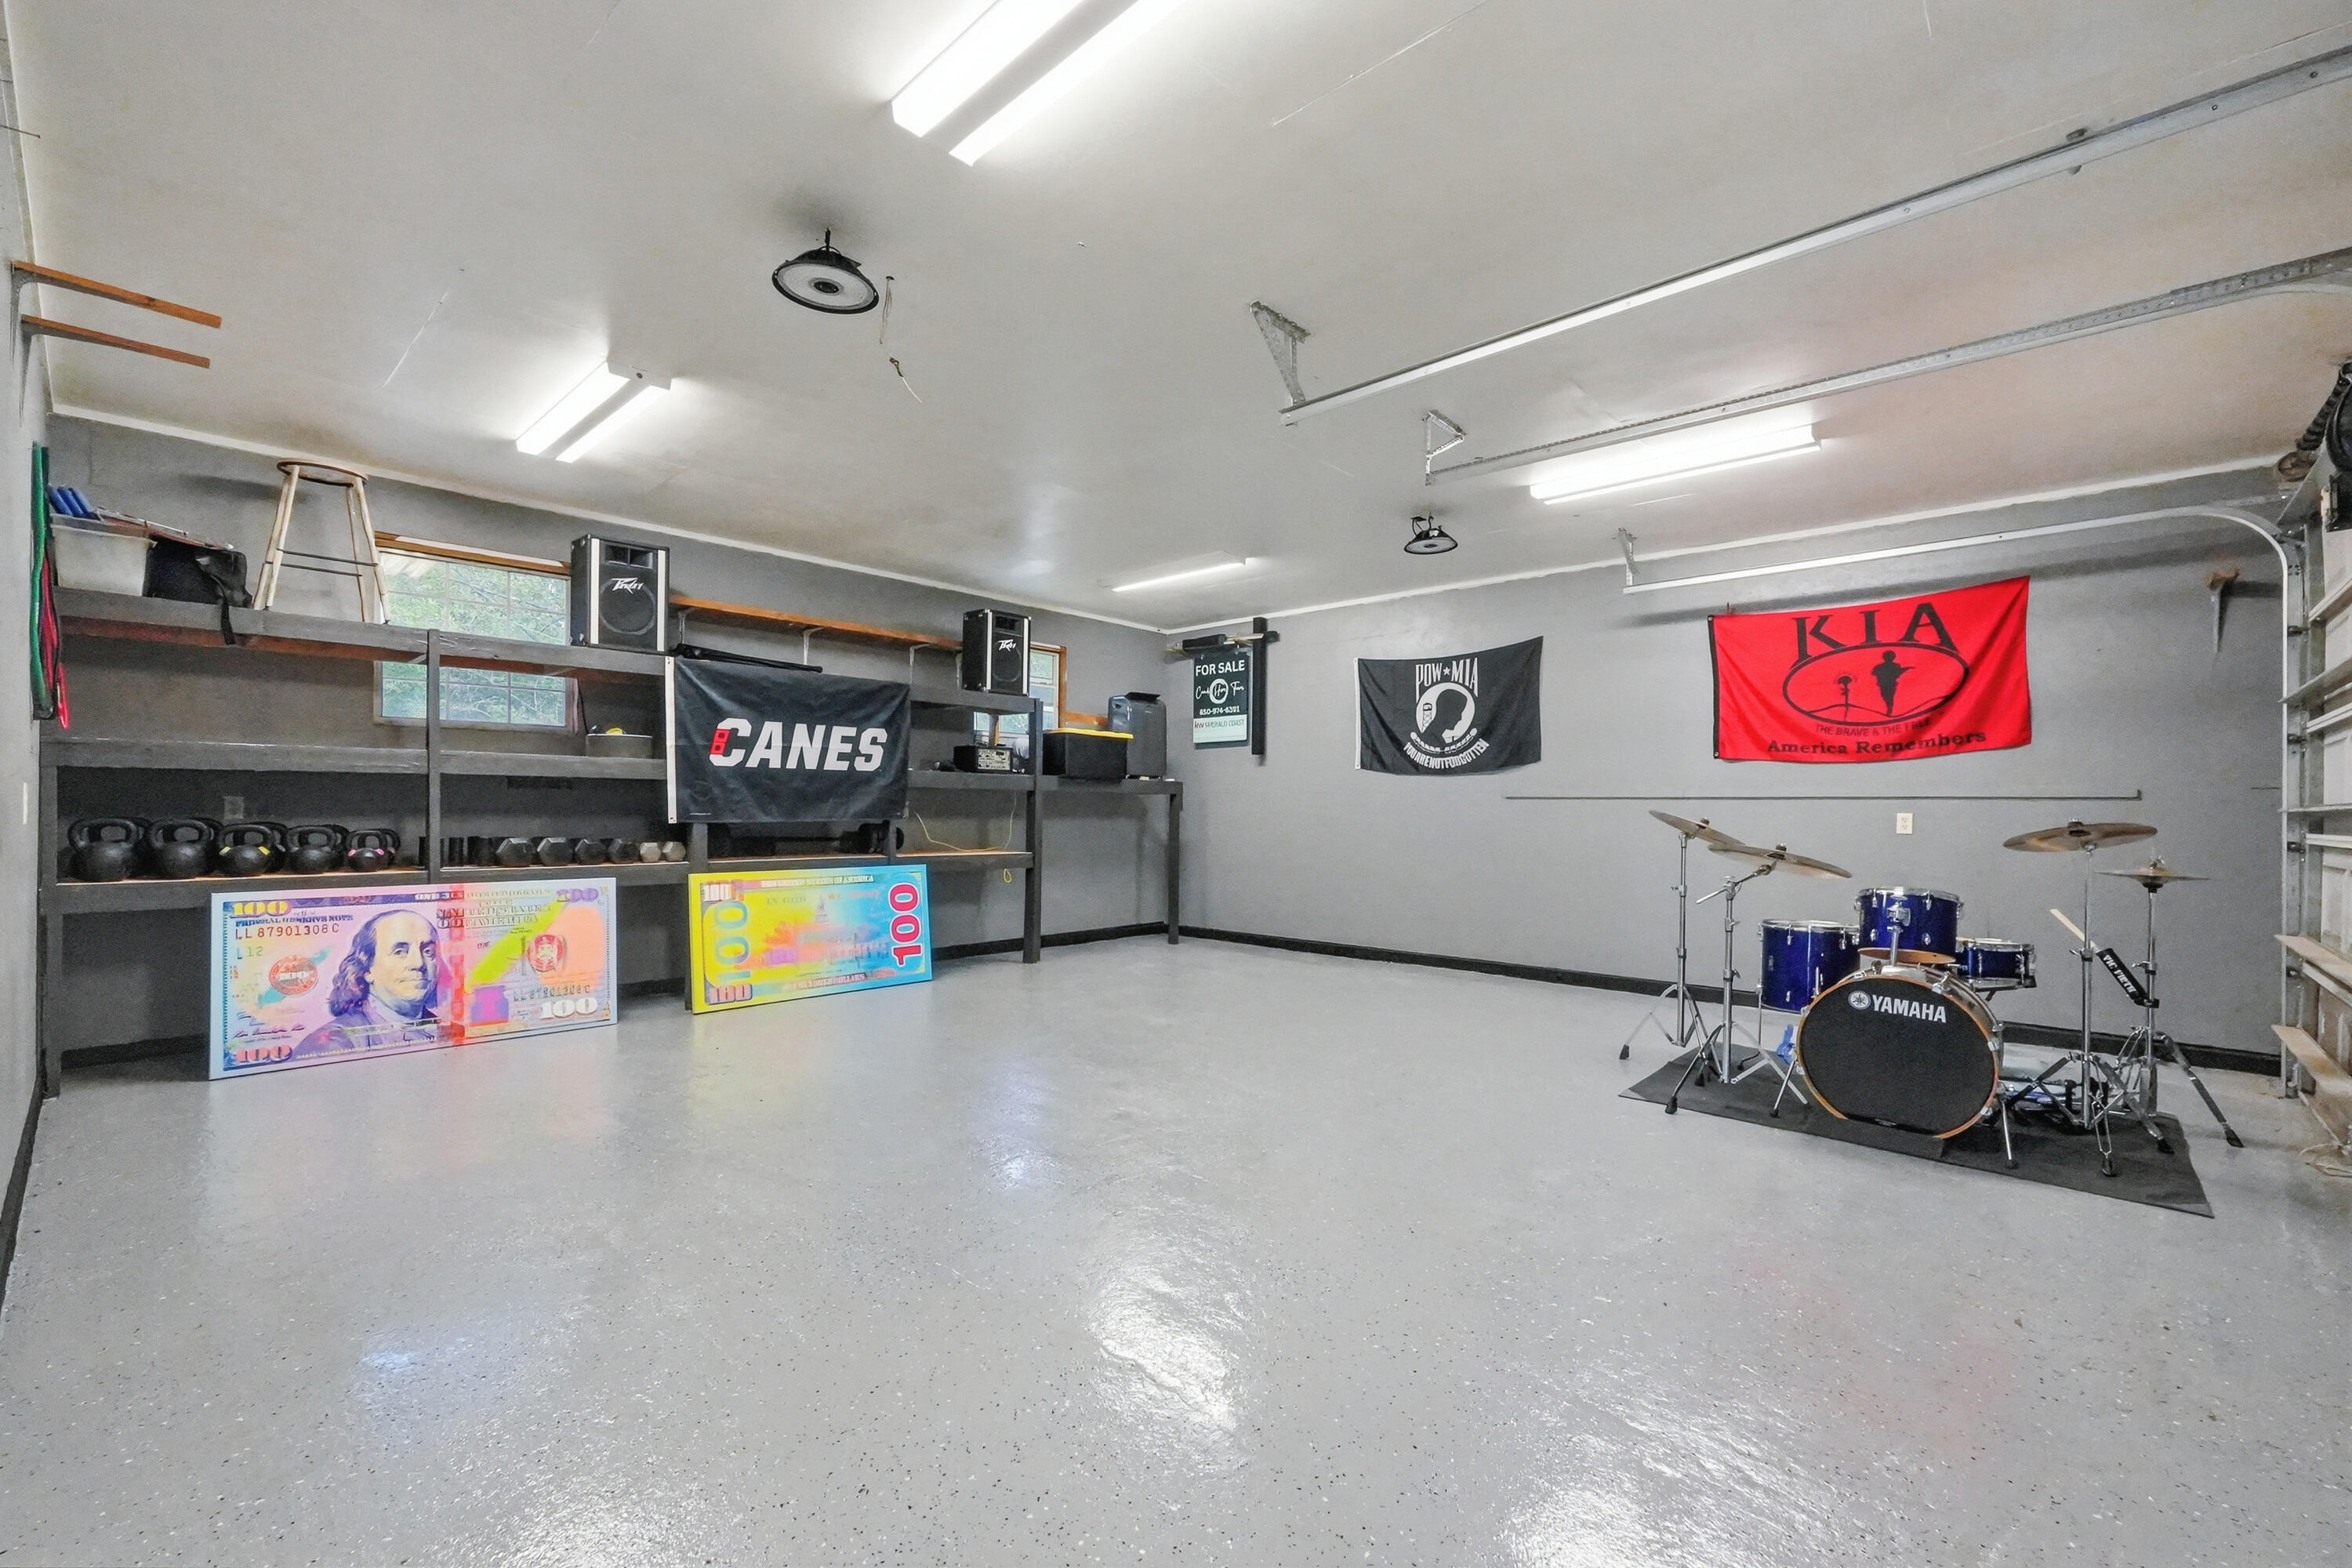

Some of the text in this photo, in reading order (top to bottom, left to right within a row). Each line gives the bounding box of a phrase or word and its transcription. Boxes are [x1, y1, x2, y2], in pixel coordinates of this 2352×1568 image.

[1791, 602, 1958, 663] KIA
[1196, 659, 1245, 677] FOR SALE
[1415, 657, 1478, 703] POW MIA
[1816, 724, 1833, 735] THE
[1835, 727, 1869, 736] BRAVE
[1883, 724, 1901, 735] THE
[709, 717, 888, 771] CANES
[1767, 730, 1987, 754] America Remembers
[233, 901, 289, 916] 100
[888, 883, 923, 967] 100
[2103, 954, 2118, 969] VIC
[540, 996, 598, 1019] 100
[1872, 994, 1947, 1023] YAMAHA
[236, 1044, 292, 1062] 100
